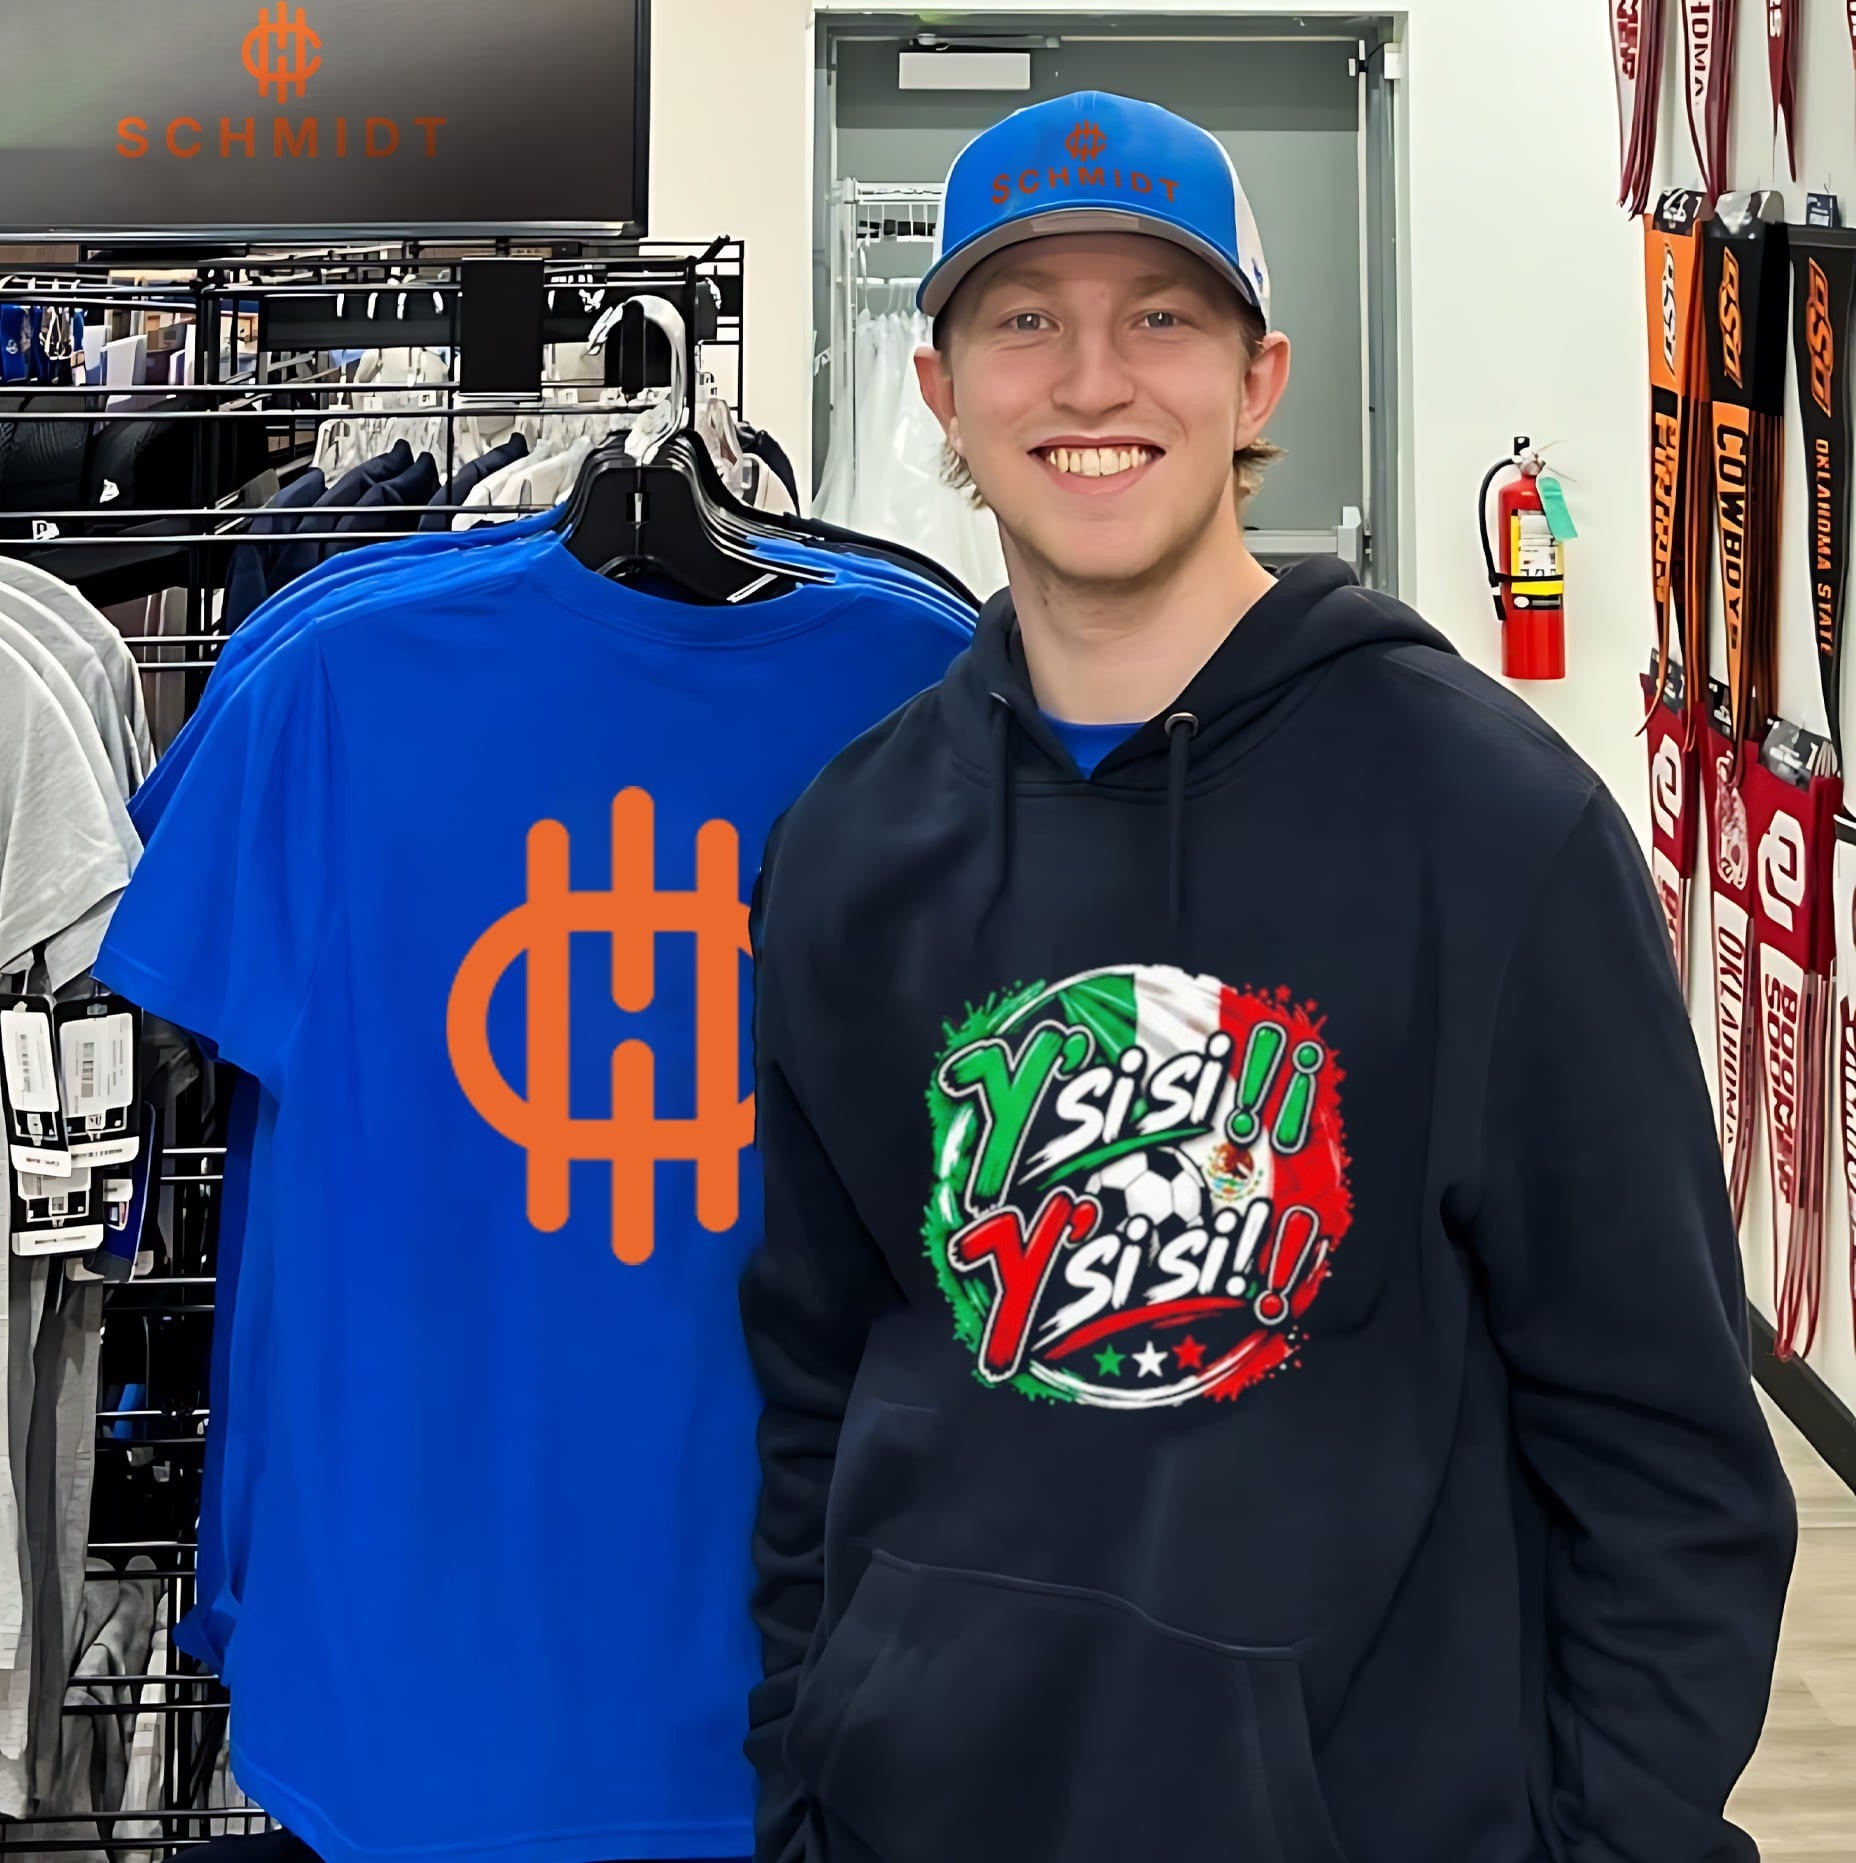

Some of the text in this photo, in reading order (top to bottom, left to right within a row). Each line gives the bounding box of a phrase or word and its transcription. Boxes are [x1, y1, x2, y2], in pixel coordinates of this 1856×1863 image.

[116, 116, 448, 158] SCHMIDT
[991, 167, 1179, 205] SCHMIDT
[1815, 438, 1832, 570] OKLAHOMA
